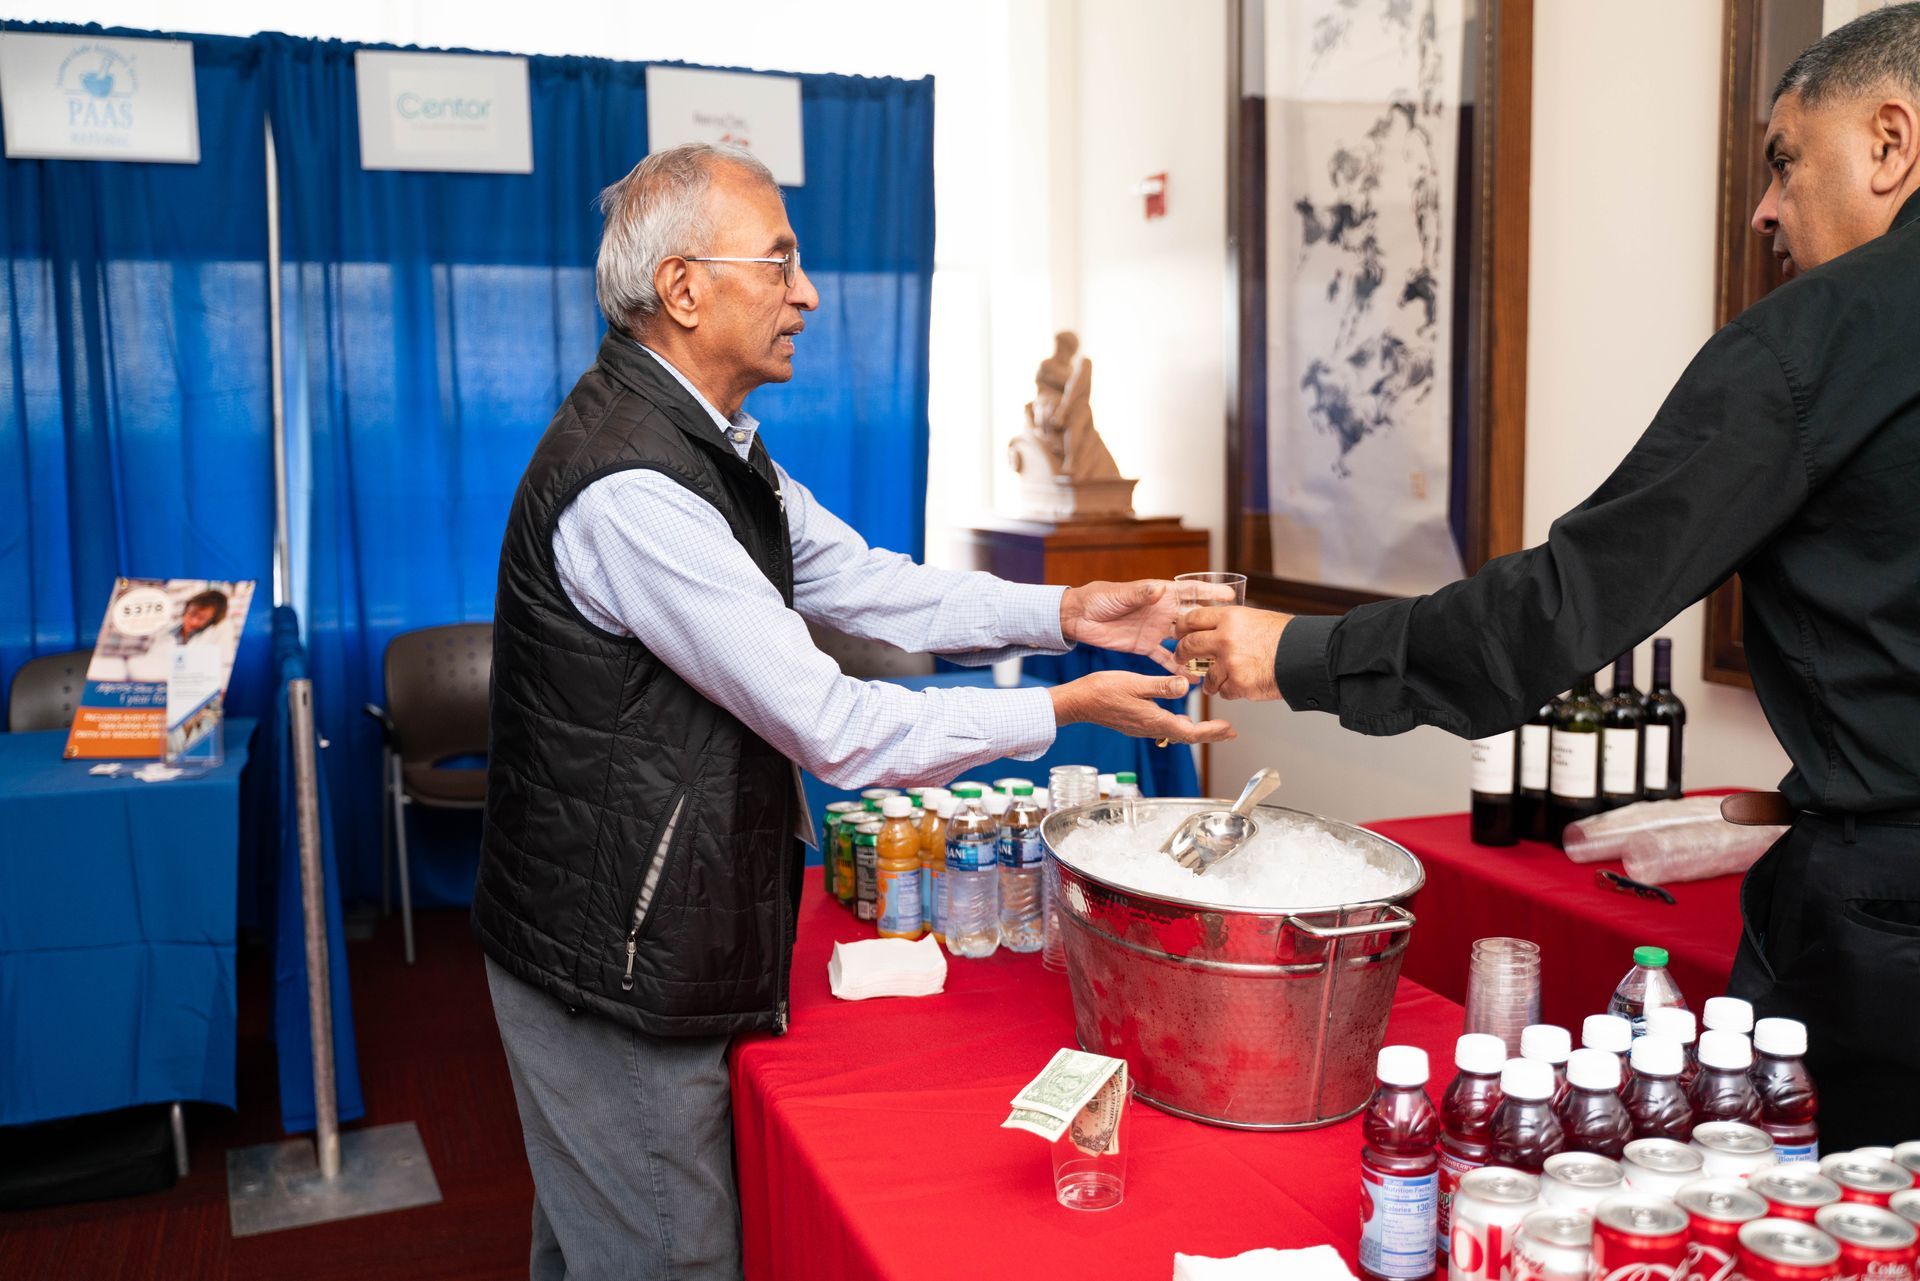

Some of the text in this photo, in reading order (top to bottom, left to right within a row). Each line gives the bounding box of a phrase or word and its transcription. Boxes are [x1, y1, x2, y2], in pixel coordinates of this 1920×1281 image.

[67, 99, 135, 129] PAAS
[396, 92, 492, 119] Centor
[1384, 1184, 1413, 1194] Nutrition
[1384, 1202, 1430, 1212] Calories 130
[1451, 1224, 1511, 1281] ok
